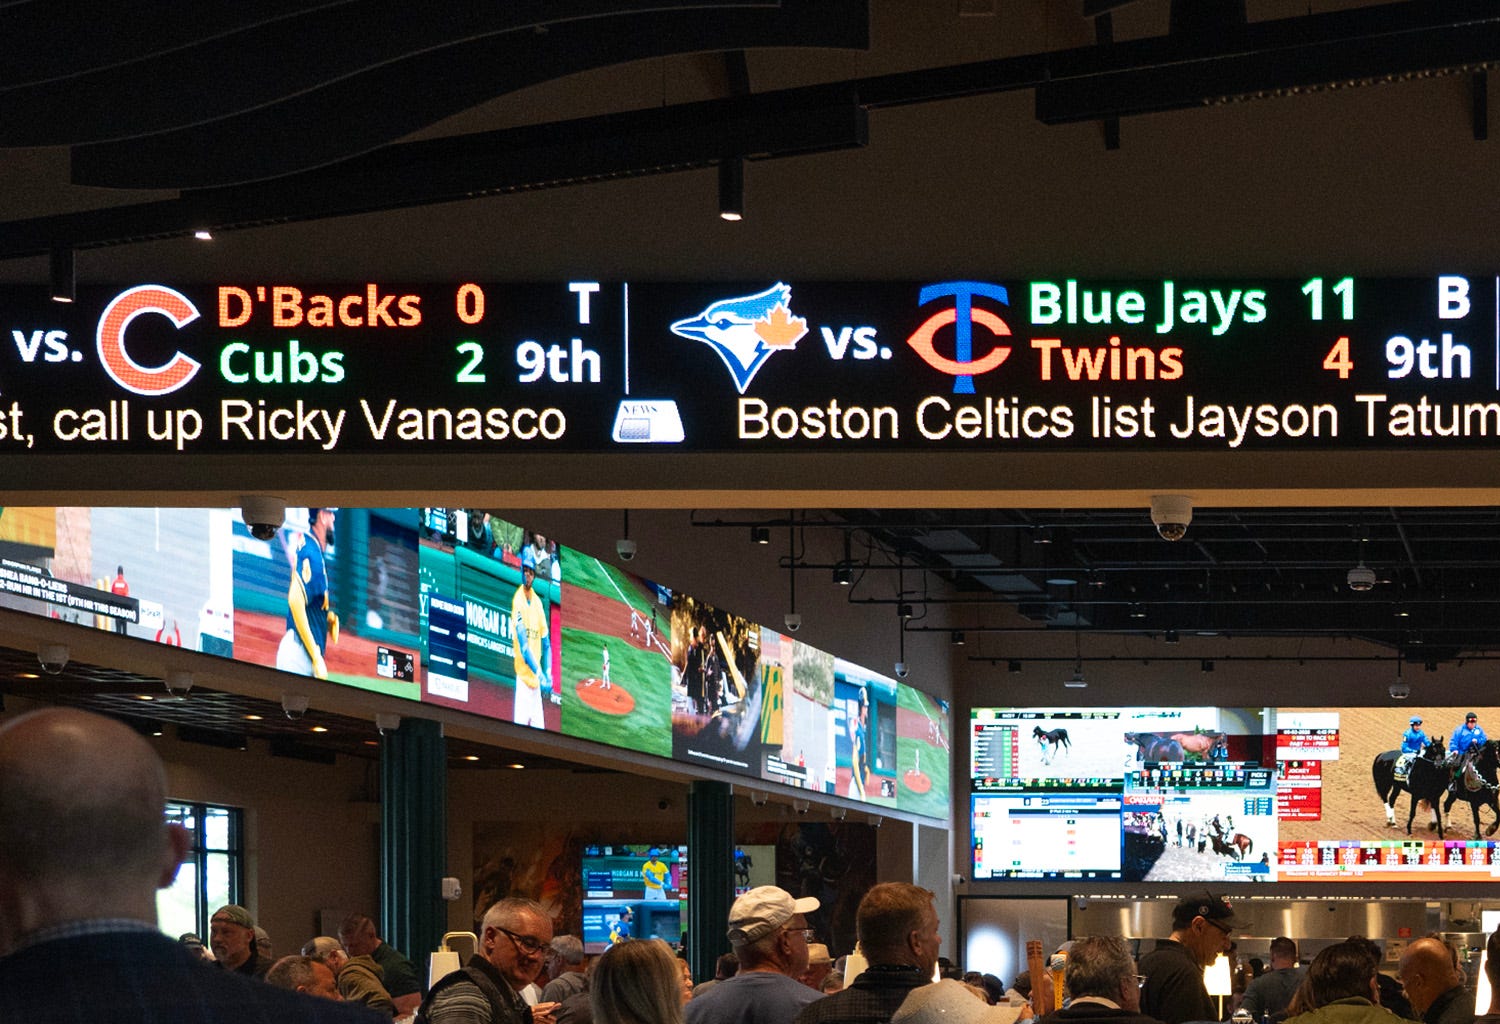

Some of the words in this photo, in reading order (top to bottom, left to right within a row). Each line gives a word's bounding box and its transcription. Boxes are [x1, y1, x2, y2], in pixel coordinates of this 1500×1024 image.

[219, 284, 422, 327] D'Backs
[456, 283, 484, 324] 0
[568, 281, 600, 324] T
[1030, 279, 1145, 324] Blue
[1156, 281, 1266, 335] Jays
[1302, 277, 1353, 320] 11
[1438, 274, 1471, 319] B
[12, 330, 83, 362] vs.
[220, 340, 344, 383] Cubs
[456, 342, 485, 382] 2
[516, 337, 600, 382] 9th
[820, 326, 892, 360] vs.
[1031, 336, 1183, 380] Twins
[1323, 336, 1353, 378] 4
[1385, 332, 1471, 378] 9th
[54, 400, 128, 440] call
[148, 409, 202, 448] up
[222, 400, 346, 450] Ricky
[360, 399, 566, 440] Vanasco
[739, 398, 898, 439] Boston
[916, 396, 1074, 439] Celtics
[1093, 396, 1155, 437] list
[1170, 396, 1337, 447] Jayson
[466, 601, 499, 635] MORGAN
[501, 614, 507, 637] &
